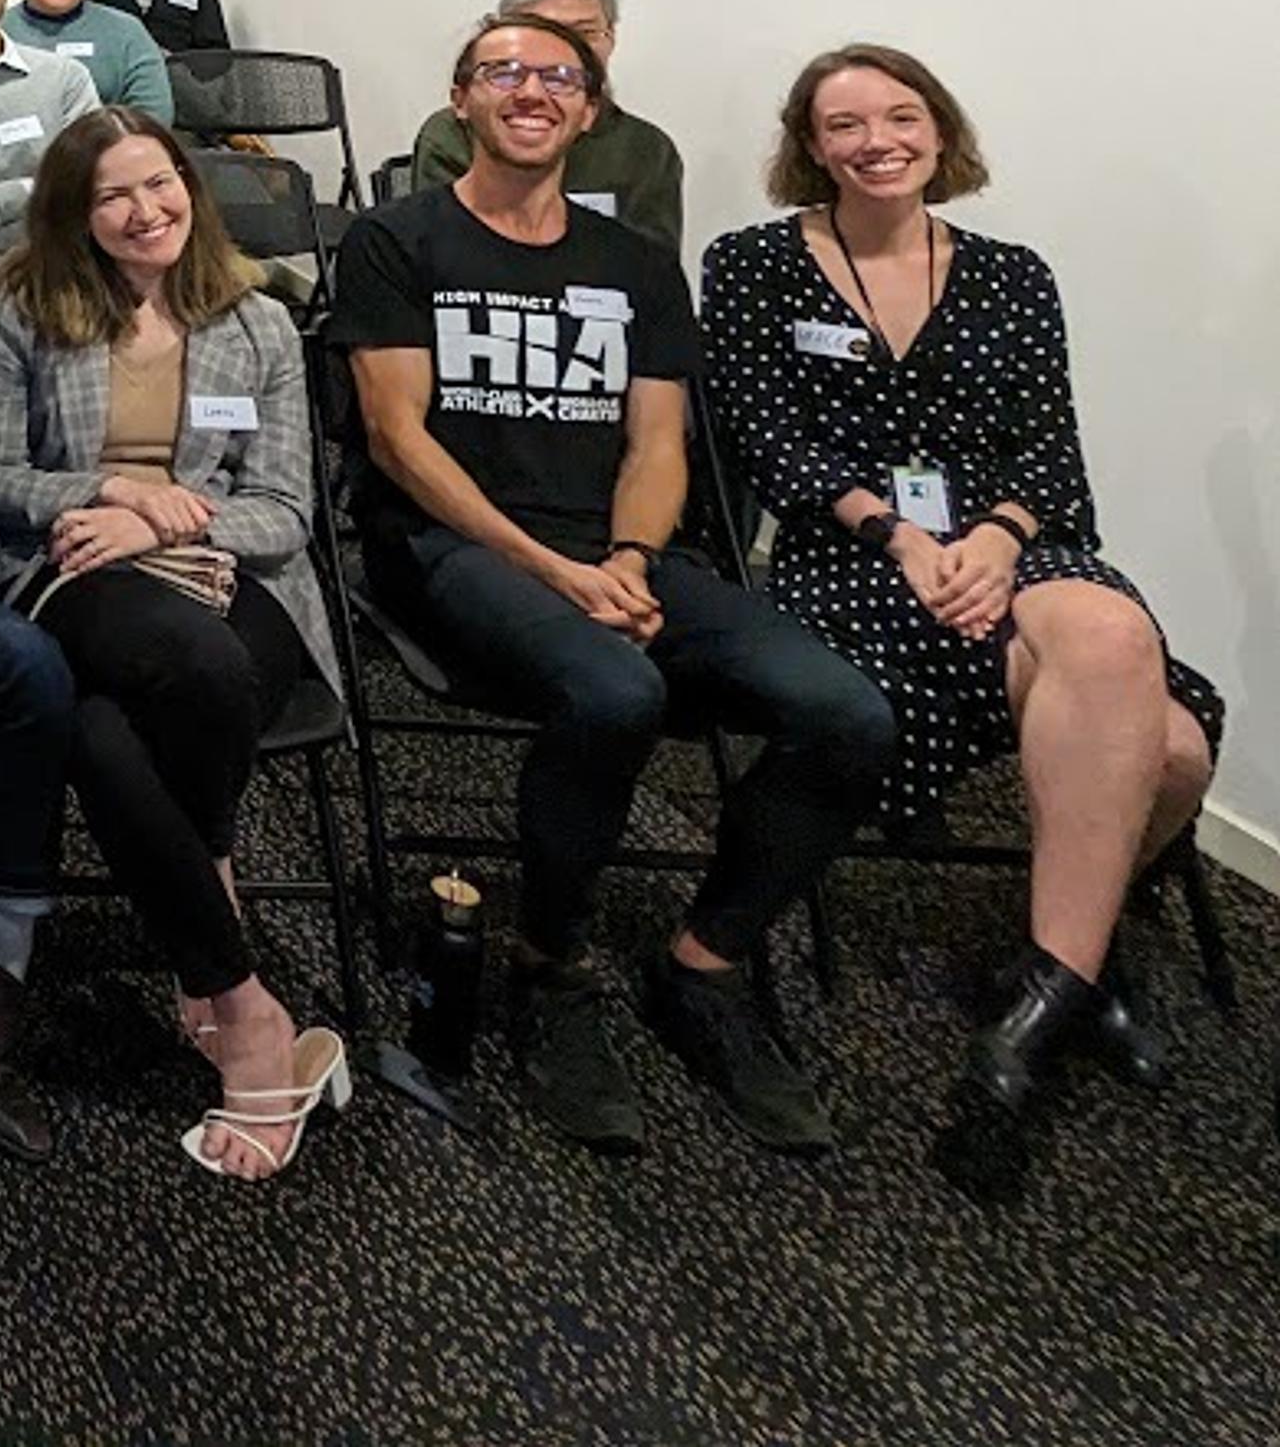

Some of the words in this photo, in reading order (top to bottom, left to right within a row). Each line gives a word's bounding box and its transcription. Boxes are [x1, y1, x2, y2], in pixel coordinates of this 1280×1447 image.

[433, 291, 481, 304] HIGH
[485, 292, 553, 310] IMPACT
[433, 308, 629, 392] HIA
